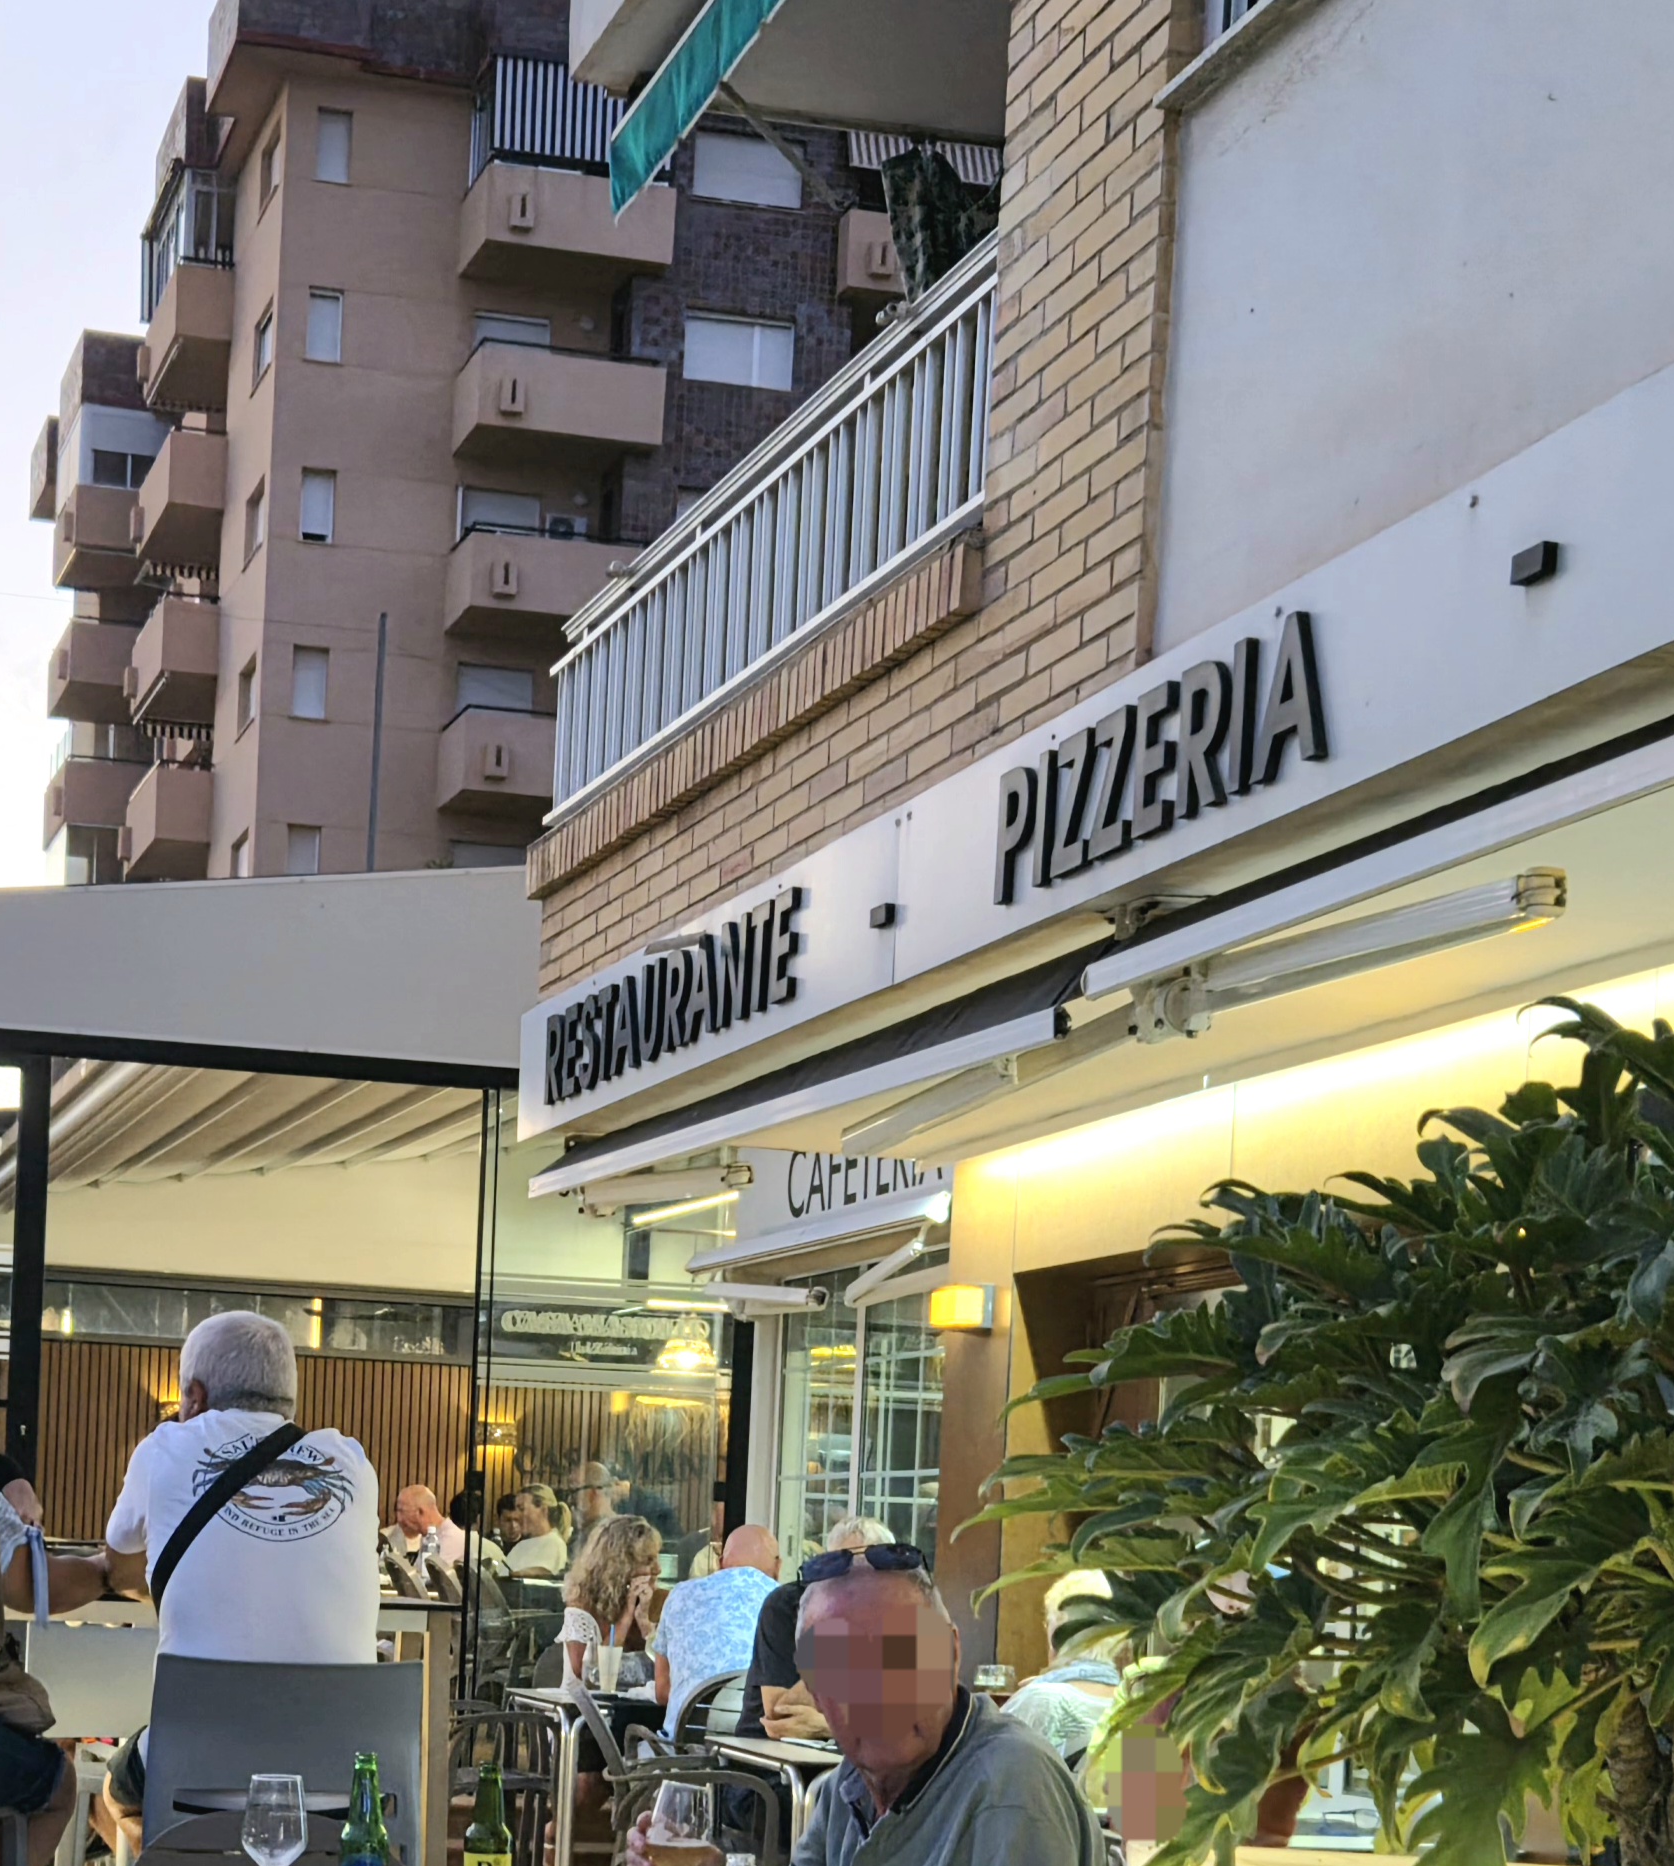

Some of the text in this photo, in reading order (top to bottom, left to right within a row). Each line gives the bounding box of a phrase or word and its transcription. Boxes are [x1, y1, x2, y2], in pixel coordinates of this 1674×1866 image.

[994, 609, 1329, 906] PIZZERIA
[544, 885, 812, 1107] RESTAURANTE
[241, 1519, 286, 1536] REFUGE
[288, 1527, 299, 1536] IN
[301, 1517, 320, 1532] THE
